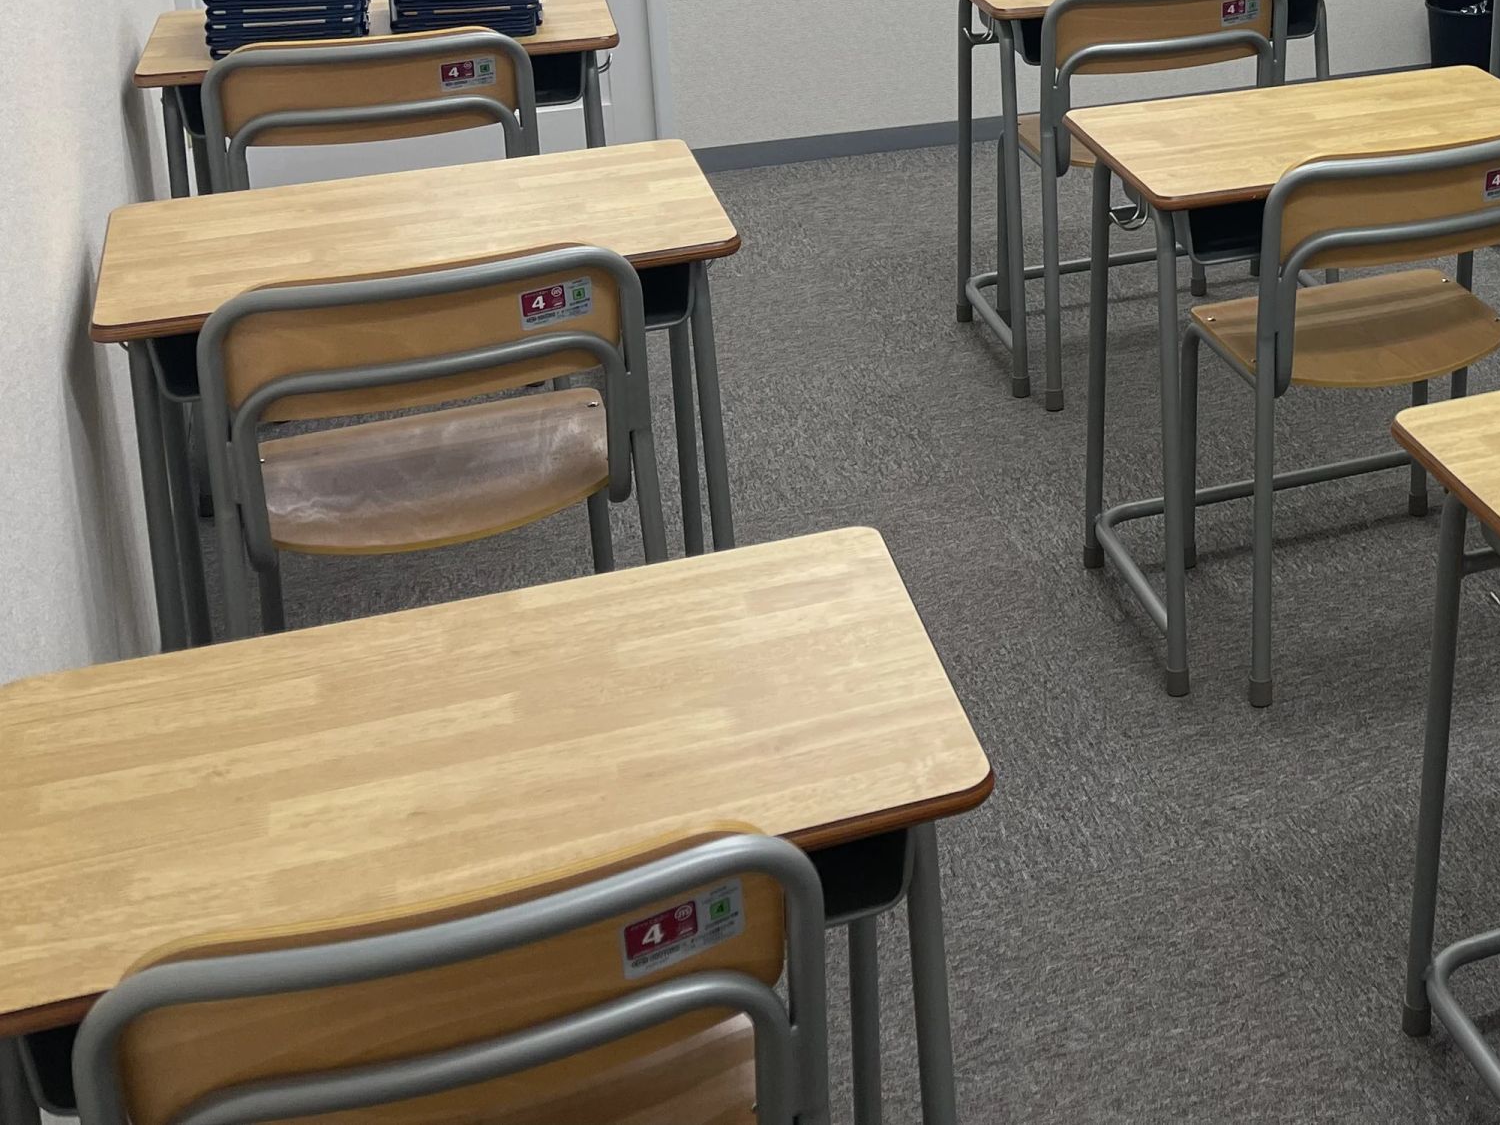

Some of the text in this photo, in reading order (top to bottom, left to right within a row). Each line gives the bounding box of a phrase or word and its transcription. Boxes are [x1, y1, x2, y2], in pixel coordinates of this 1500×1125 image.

[1227, 4, 1235, 14] 4
[448, 66, 460, 78] 4
[1492, 174, 1500, 186] 4
[531, 295, 546, 310] 4
[642, 922, 665, 946] 4
